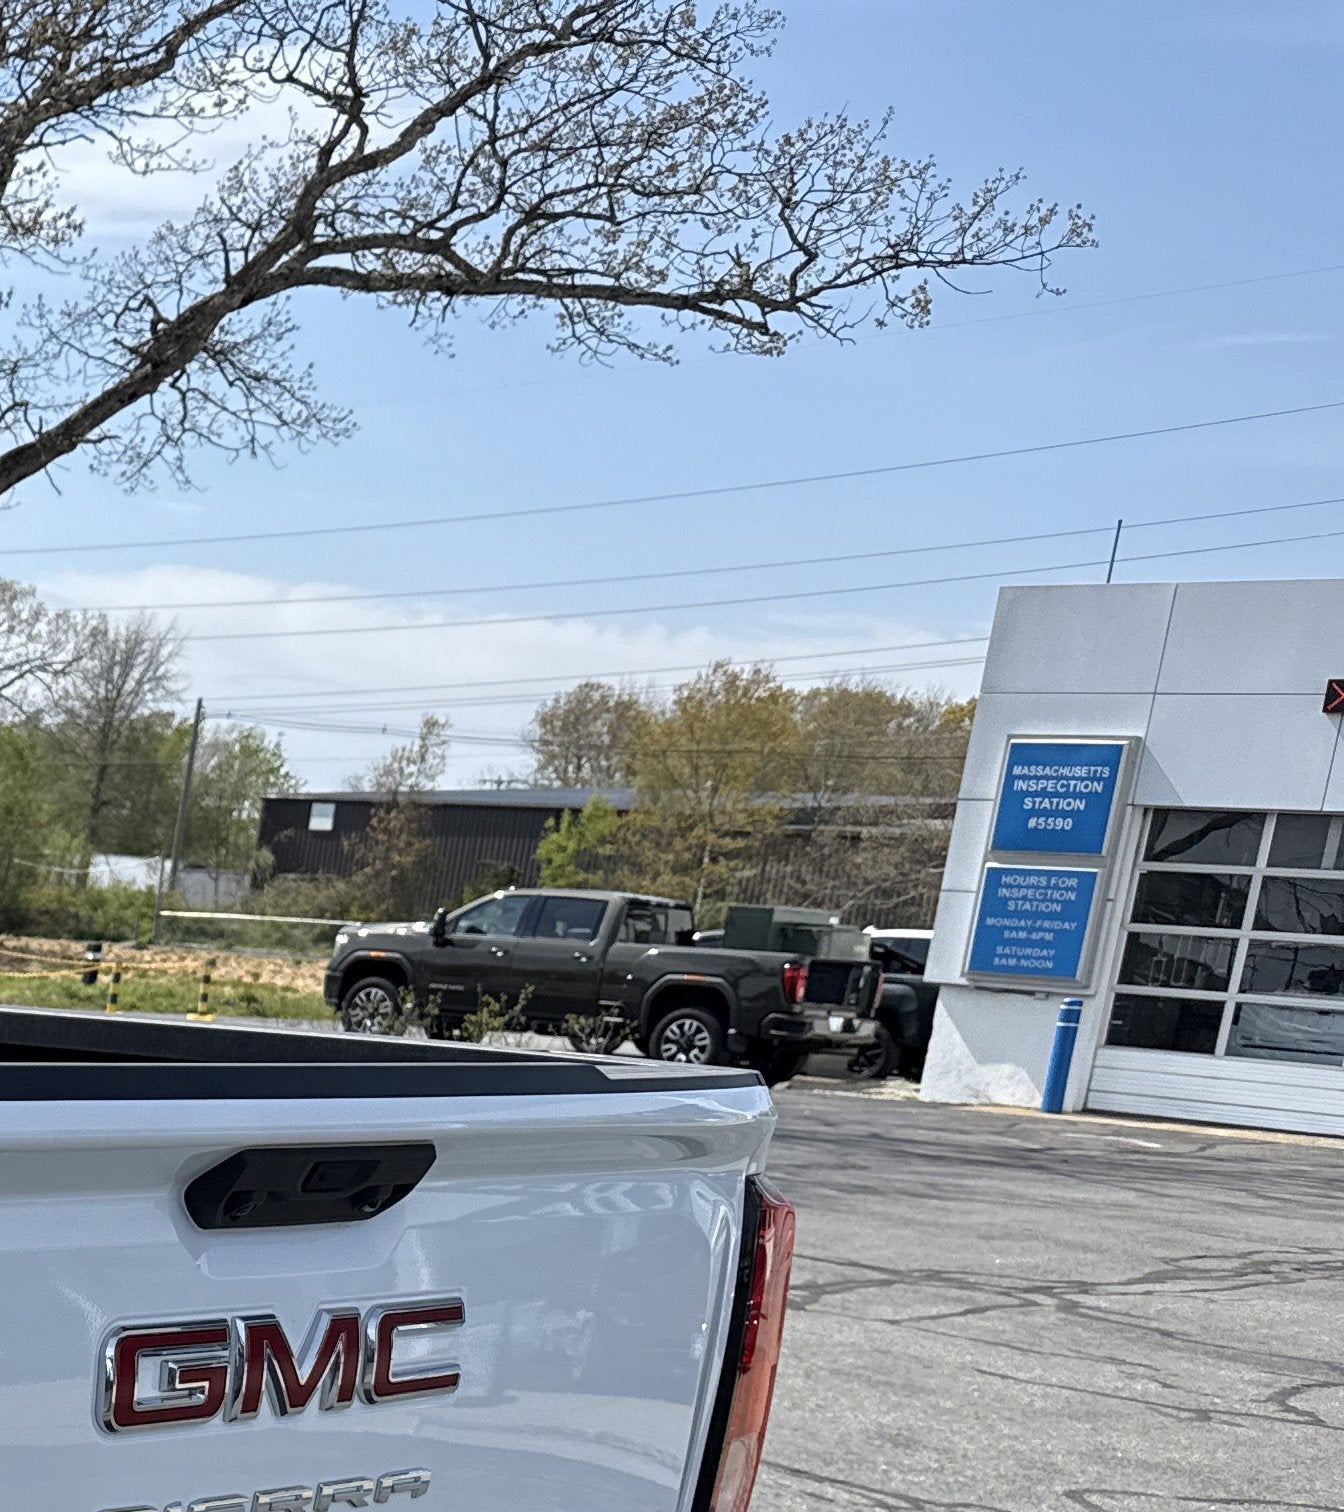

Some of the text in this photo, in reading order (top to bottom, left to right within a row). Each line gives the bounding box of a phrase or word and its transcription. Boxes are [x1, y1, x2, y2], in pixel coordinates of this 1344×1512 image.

[1012, 765, 1110, 777] MASSACHUSETTS
[1014, 779, 1104, 793] INSPECTION
[1023, 797, 1086, 811] STATION
[1028, 817, 1073, 830] #5590
[1001, 874, 1079, 888] HOURS FOR
[997, 887, 1077, 901] INSPECTION
[1007, 900, 1062, 912] STATION
[995, 945, 1055, 957] SATURDAY
[96, 1295, 466, 1433] GMC
